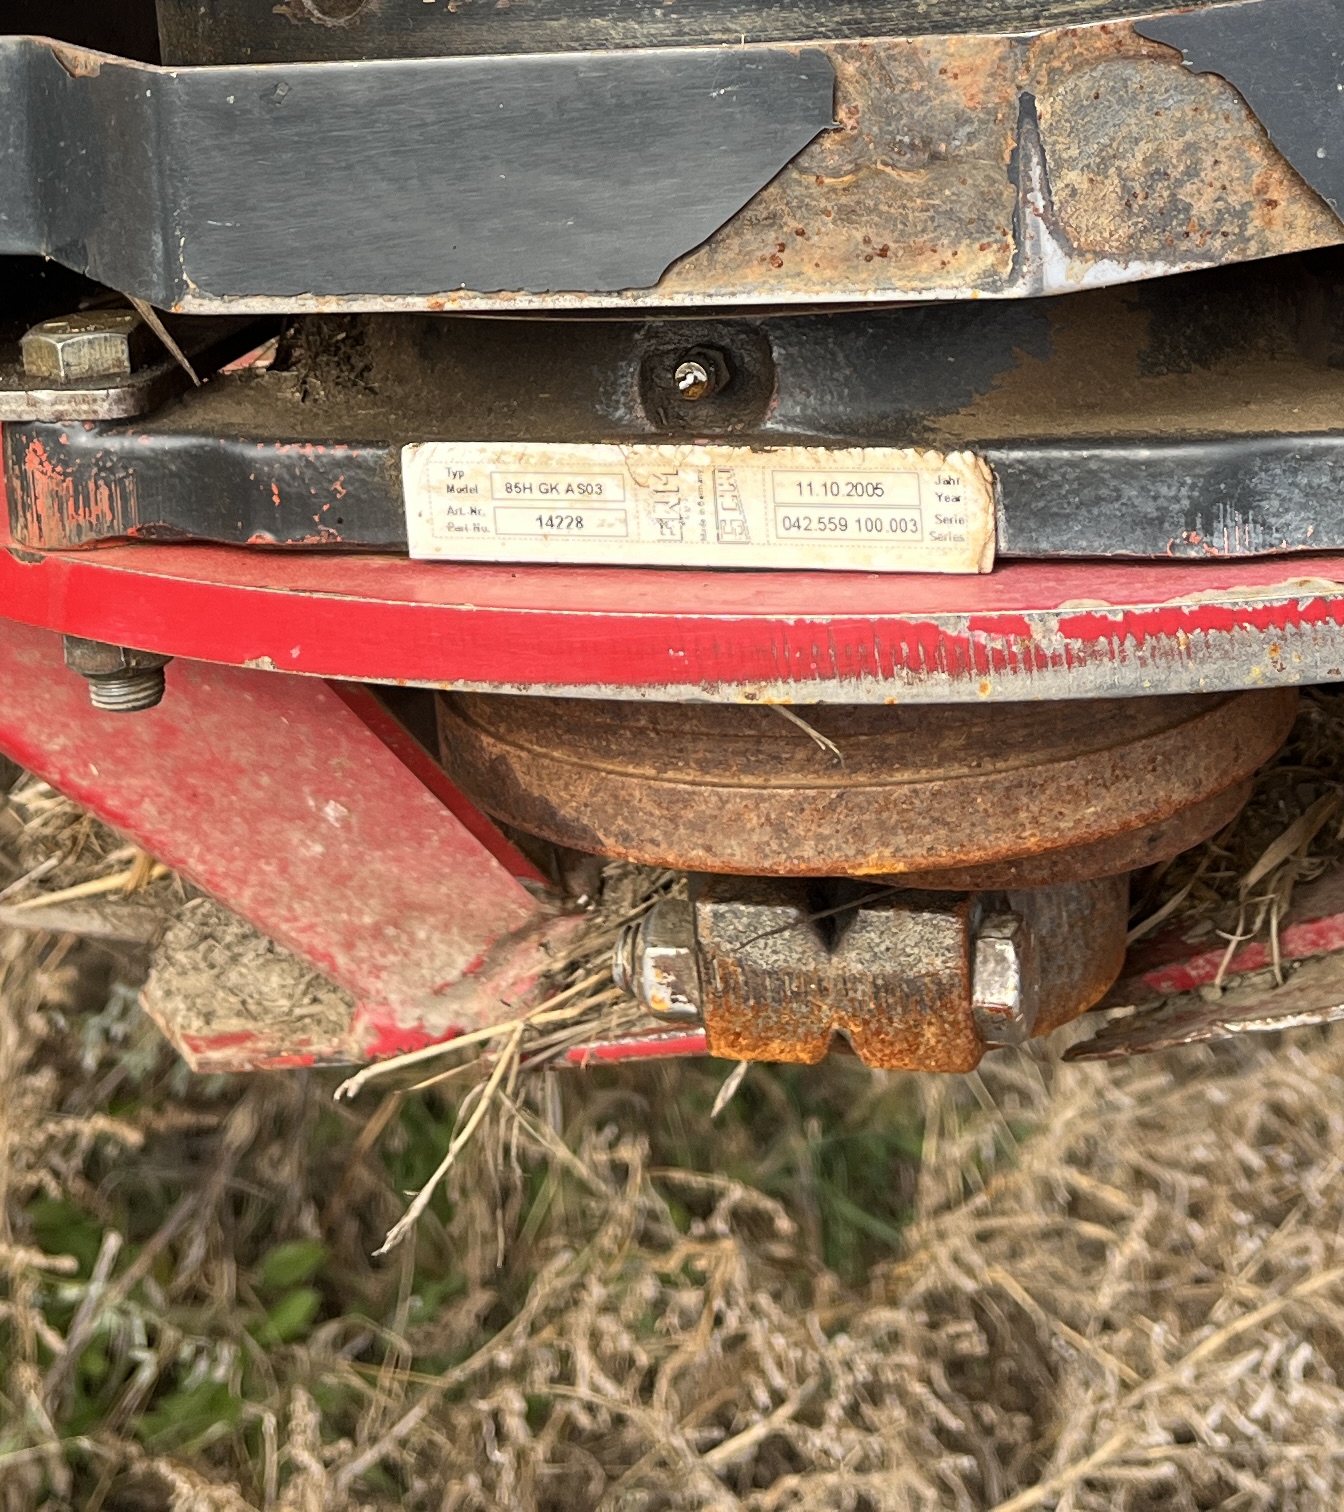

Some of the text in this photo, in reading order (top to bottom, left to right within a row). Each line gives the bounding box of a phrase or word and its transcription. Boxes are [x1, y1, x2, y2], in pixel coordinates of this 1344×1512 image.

[445, 467, 465, 479] Typ
[934, 475, 961, 486] Jahr
[446, 484, 479, 494] Model
[504, 481, 533, 494] 85H
[538, 482, 560, 494] GK
[796, 481, 885, 498] 11.10.2005
[934, 491, 962, 503] Year
[535, 514, 585, 530] 14228
[782, 516, 919, 534] 042.559 100.003
[934, 514, 966, 525] Serie
[929, 531, 966, 542] Series
